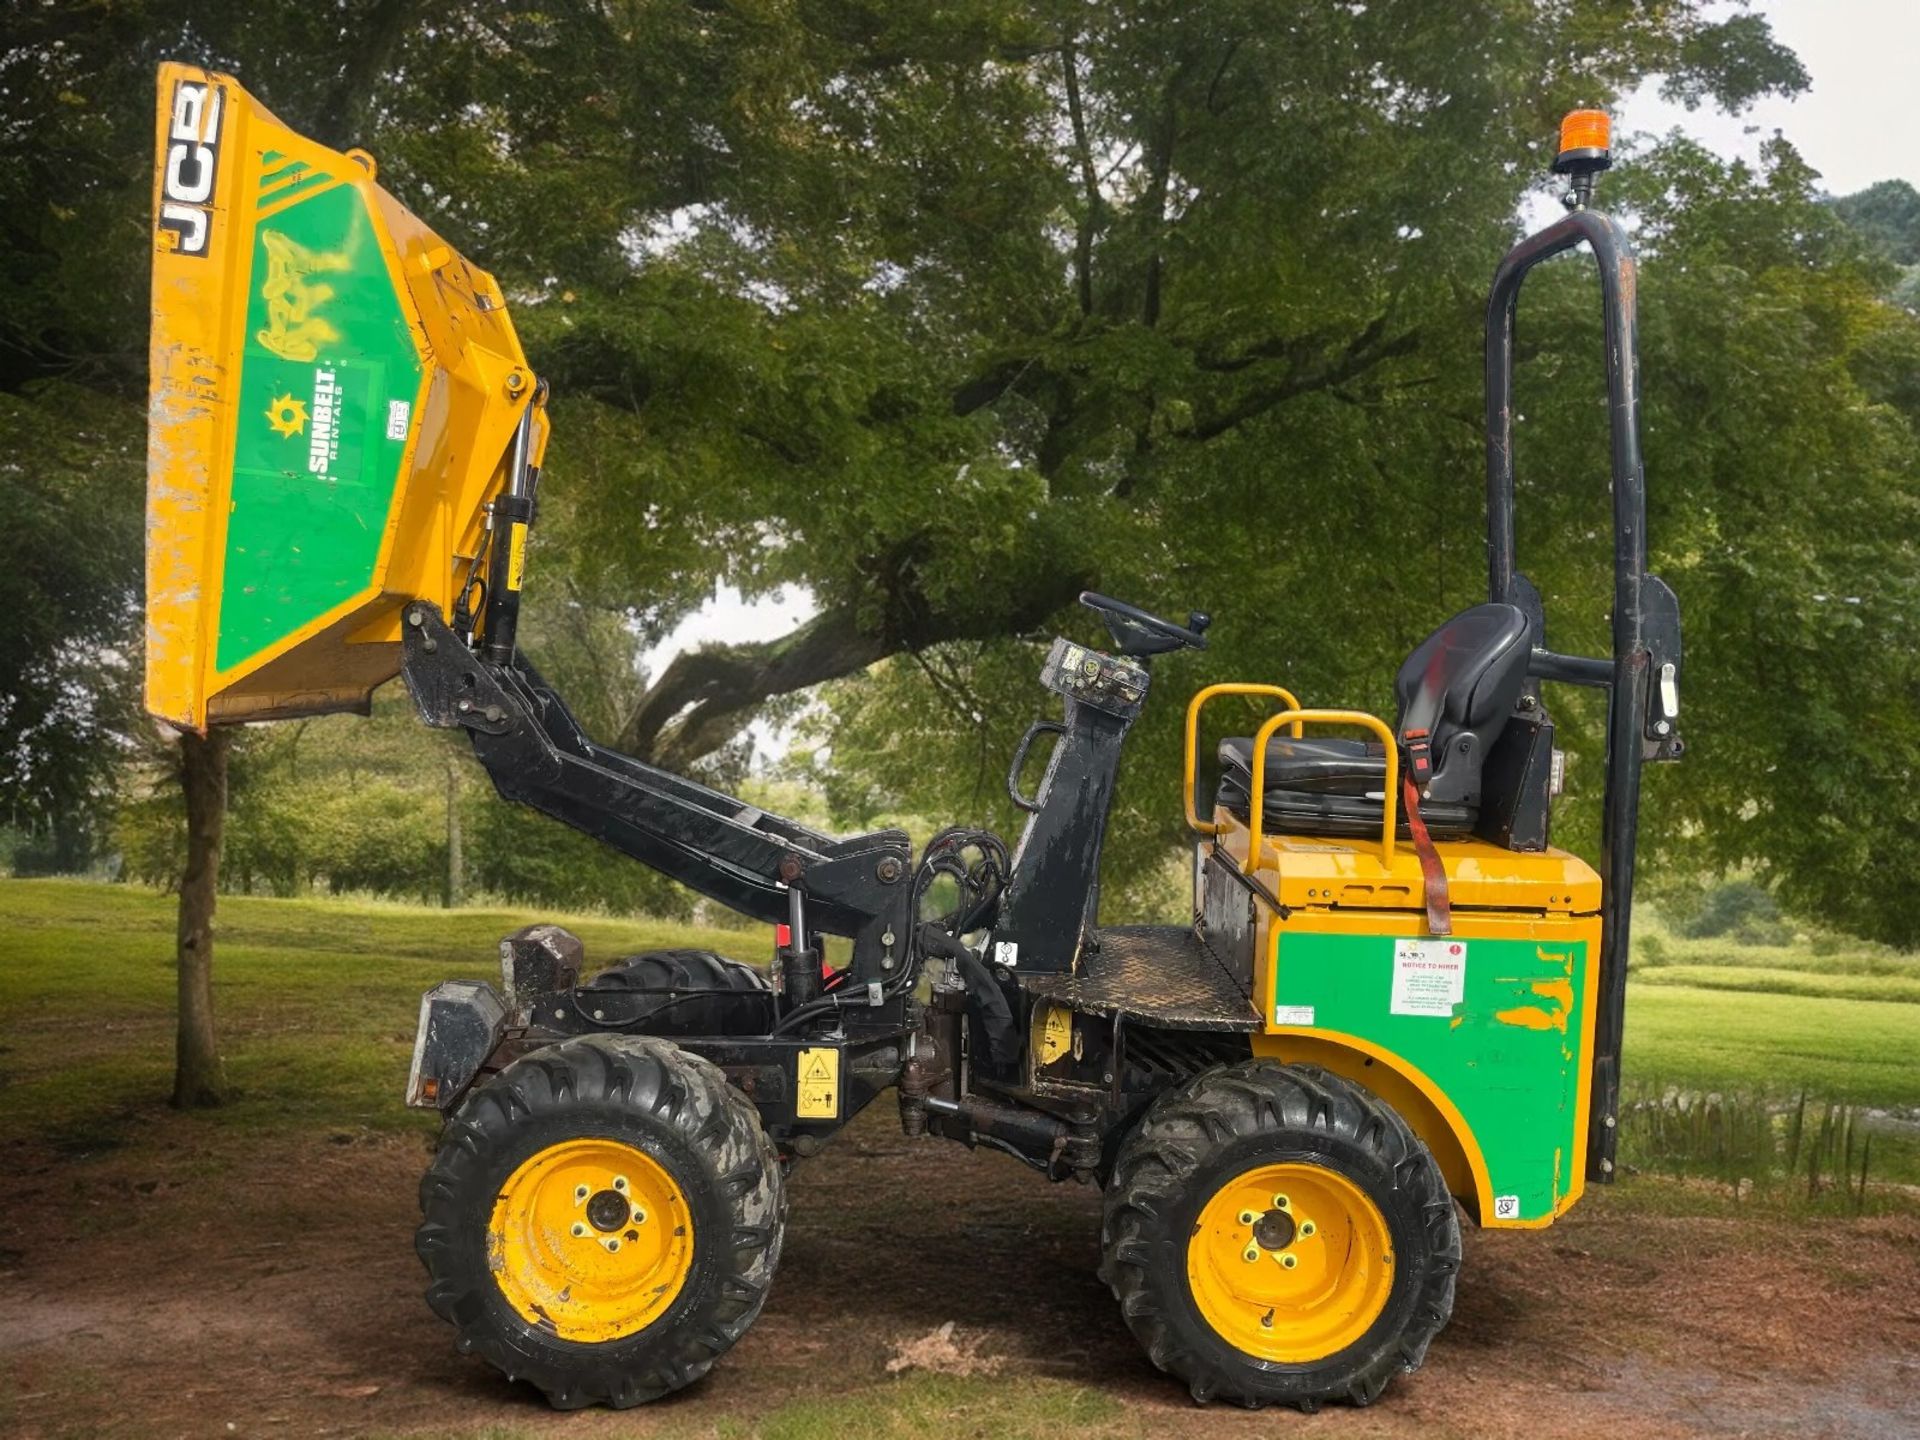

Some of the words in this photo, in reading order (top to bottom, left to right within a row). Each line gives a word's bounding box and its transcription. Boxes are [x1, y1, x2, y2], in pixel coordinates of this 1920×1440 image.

[163, 86, 220, 252] JCB
[309, 368, 335, 473] SUNBELT
[329, 386, 343, 460] RENTALS
[1402, 962, 1426, 970] NOTICE
